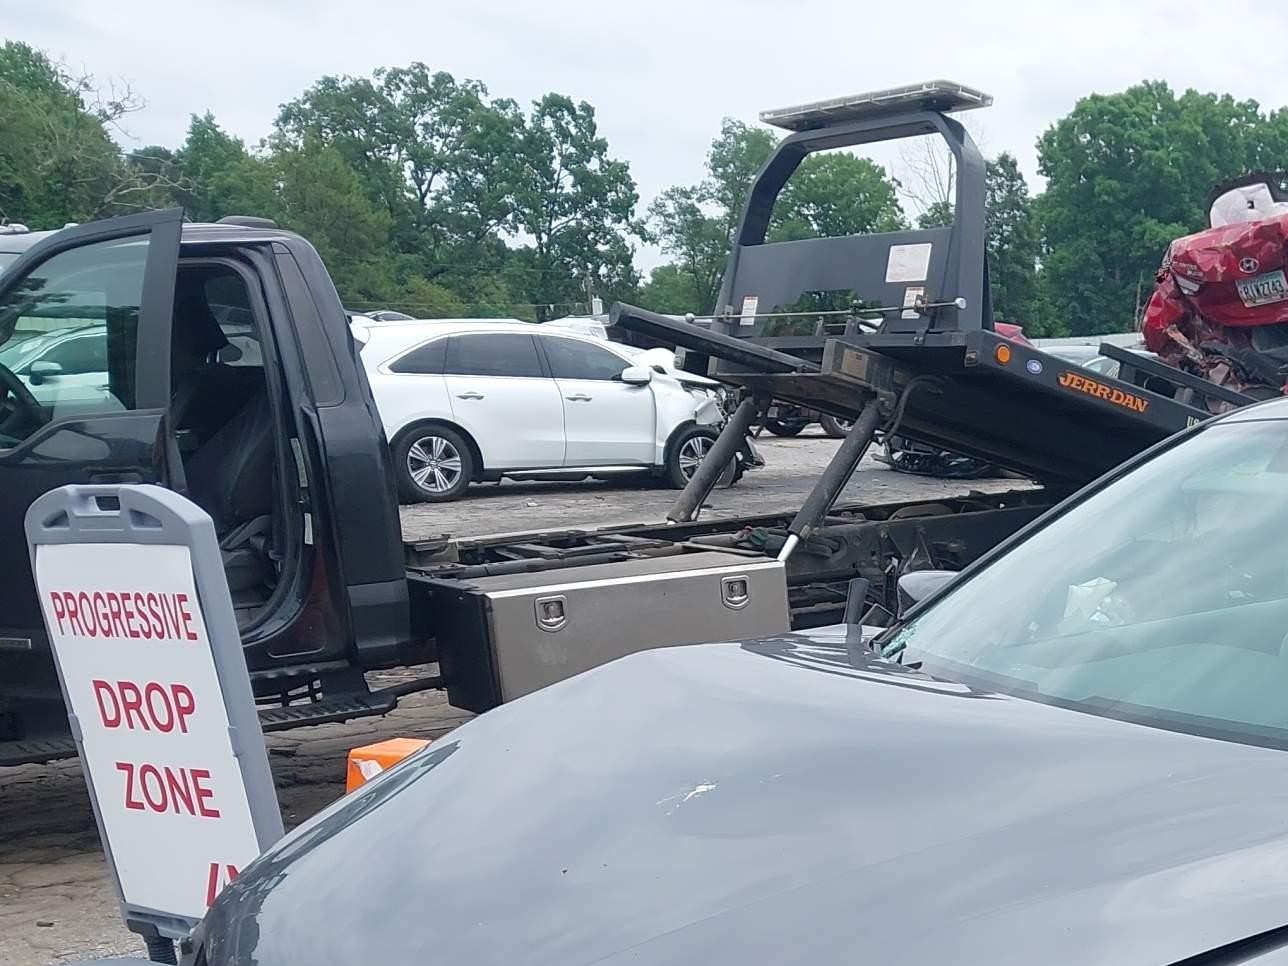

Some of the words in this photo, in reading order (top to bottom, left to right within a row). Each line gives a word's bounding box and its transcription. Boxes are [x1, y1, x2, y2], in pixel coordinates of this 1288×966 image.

[50, 591, 198, 642] PROGRESSIVE
[92, 679, 196, 734] DROP
[115, 761, 221, 819] ZONE
